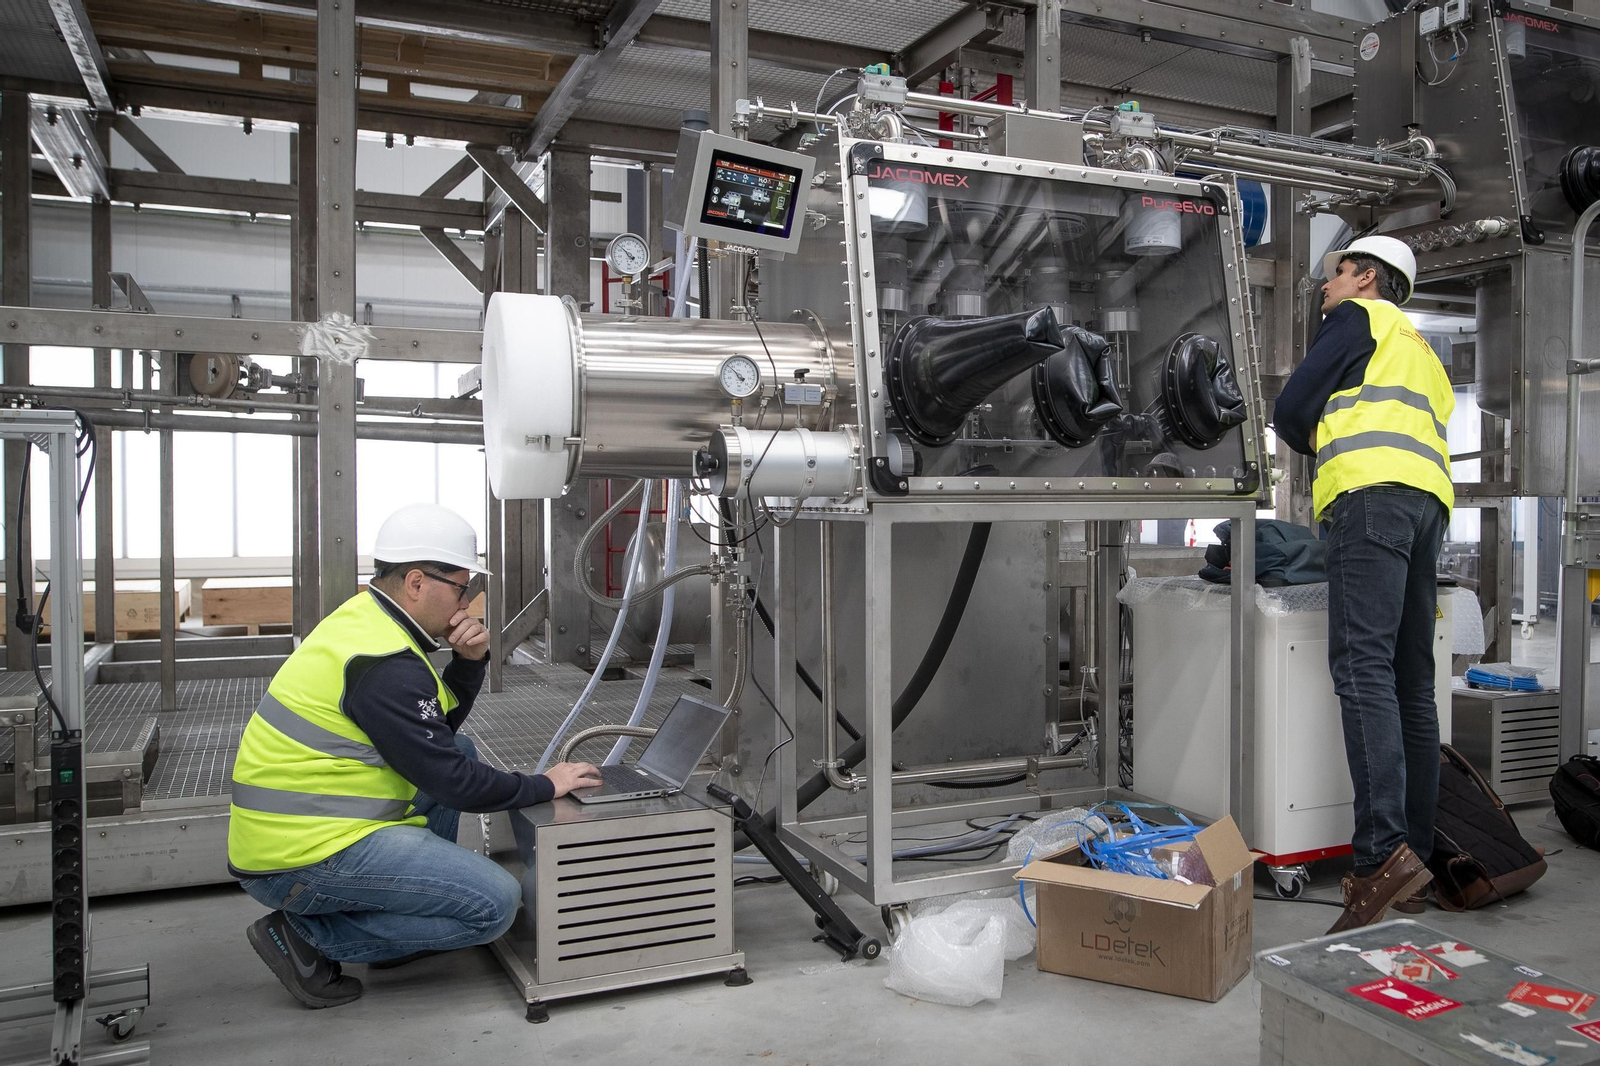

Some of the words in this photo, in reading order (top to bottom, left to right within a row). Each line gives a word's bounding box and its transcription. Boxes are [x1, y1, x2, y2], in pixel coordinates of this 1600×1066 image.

[1503, 12, 1560, 33] JACOMEX
[868, 165, 970, 188] JACOMEX
[1142, 196, 1214, 215] PureEvo
[723, 244, 759, 255] JACOMEX
[1081, 931, 1166, 967] LDetek
[1098, 953, 1151, 968] www.ldetek.com
[1406, 998, 1454, 1017] FRAGILE
